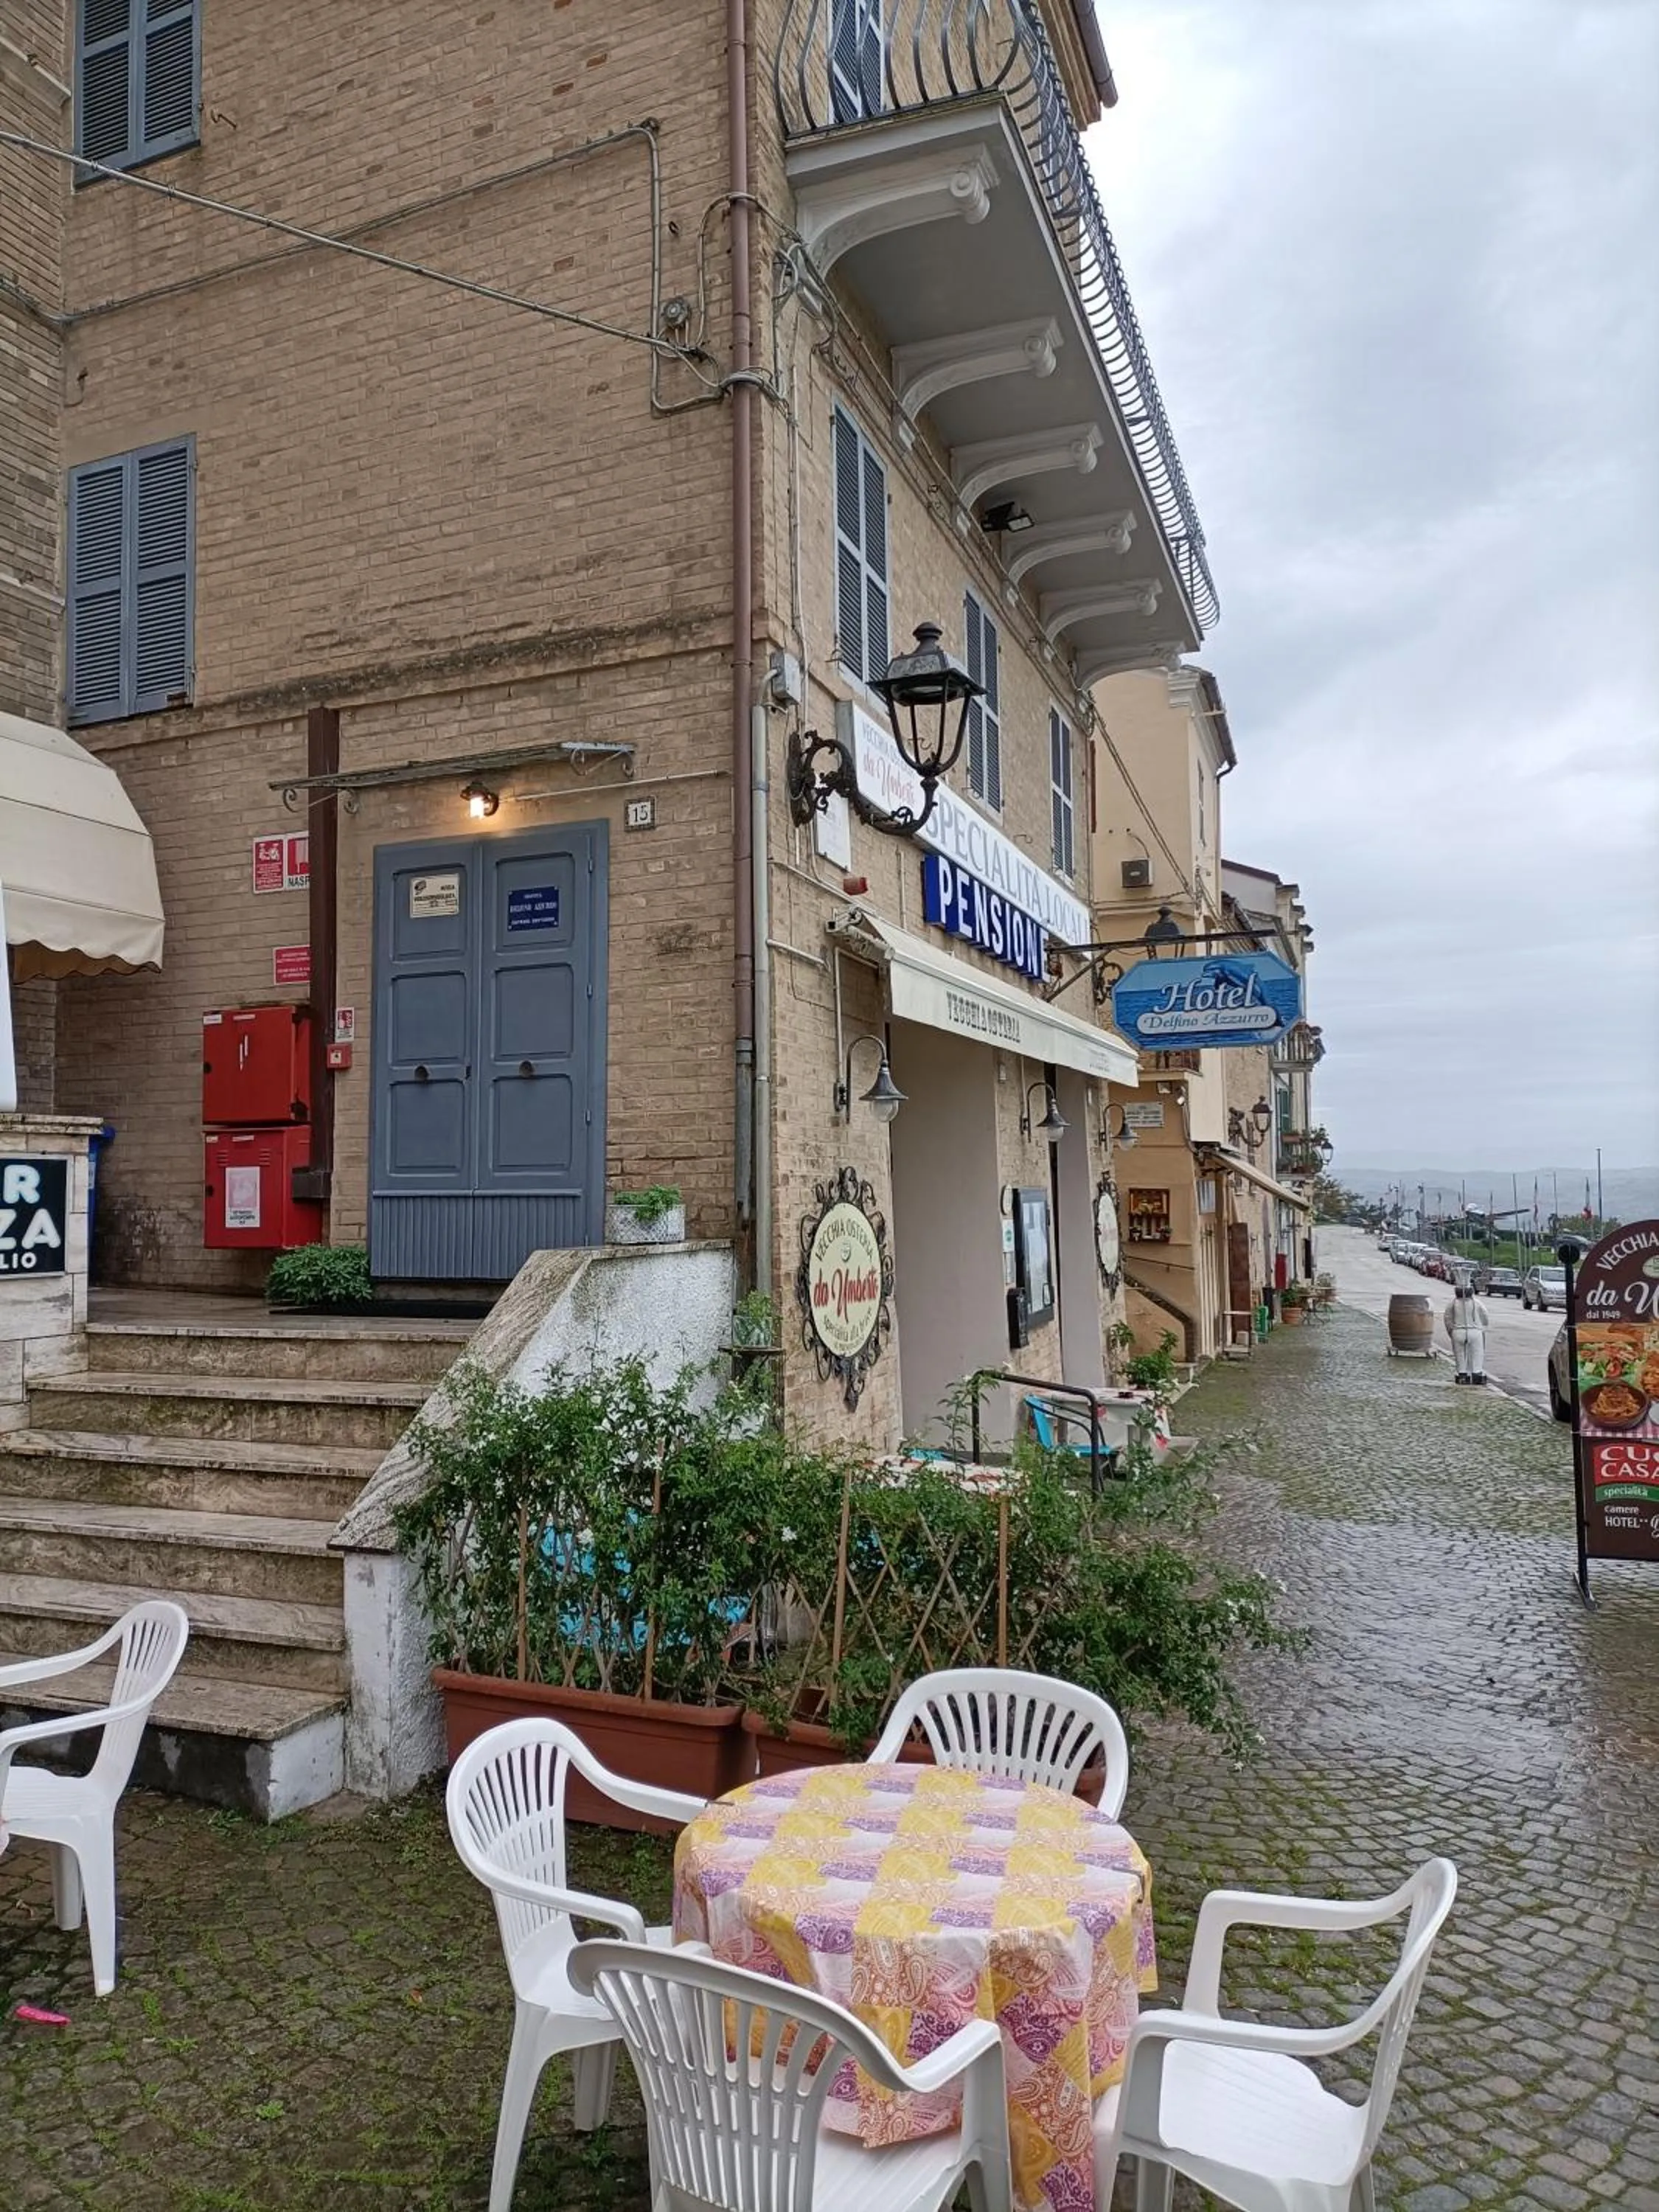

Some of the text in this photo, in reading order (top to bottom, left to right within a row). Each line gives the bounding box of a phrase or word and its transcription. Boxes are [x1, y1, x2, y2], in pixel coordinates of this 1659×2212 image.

[633, 804, 648, 822] 15
[938, 855, 1051, 983] PENSIONE
[1153, 973, 1258, 1013] Hotel
[1144, 1012, 1269, 1032] Delfino Azzurro
[815, 1218, 846, 1262] VECCHIA
[1596, 1231, 1659, 1270] VECCHIA
[813, 1267, 829, 1308] da
[1586, 1279, 1618, 1306] da
[1587, 1310, 1621, 1319] dal 1949
[1604, 1486, 1648, 1498] specialità
